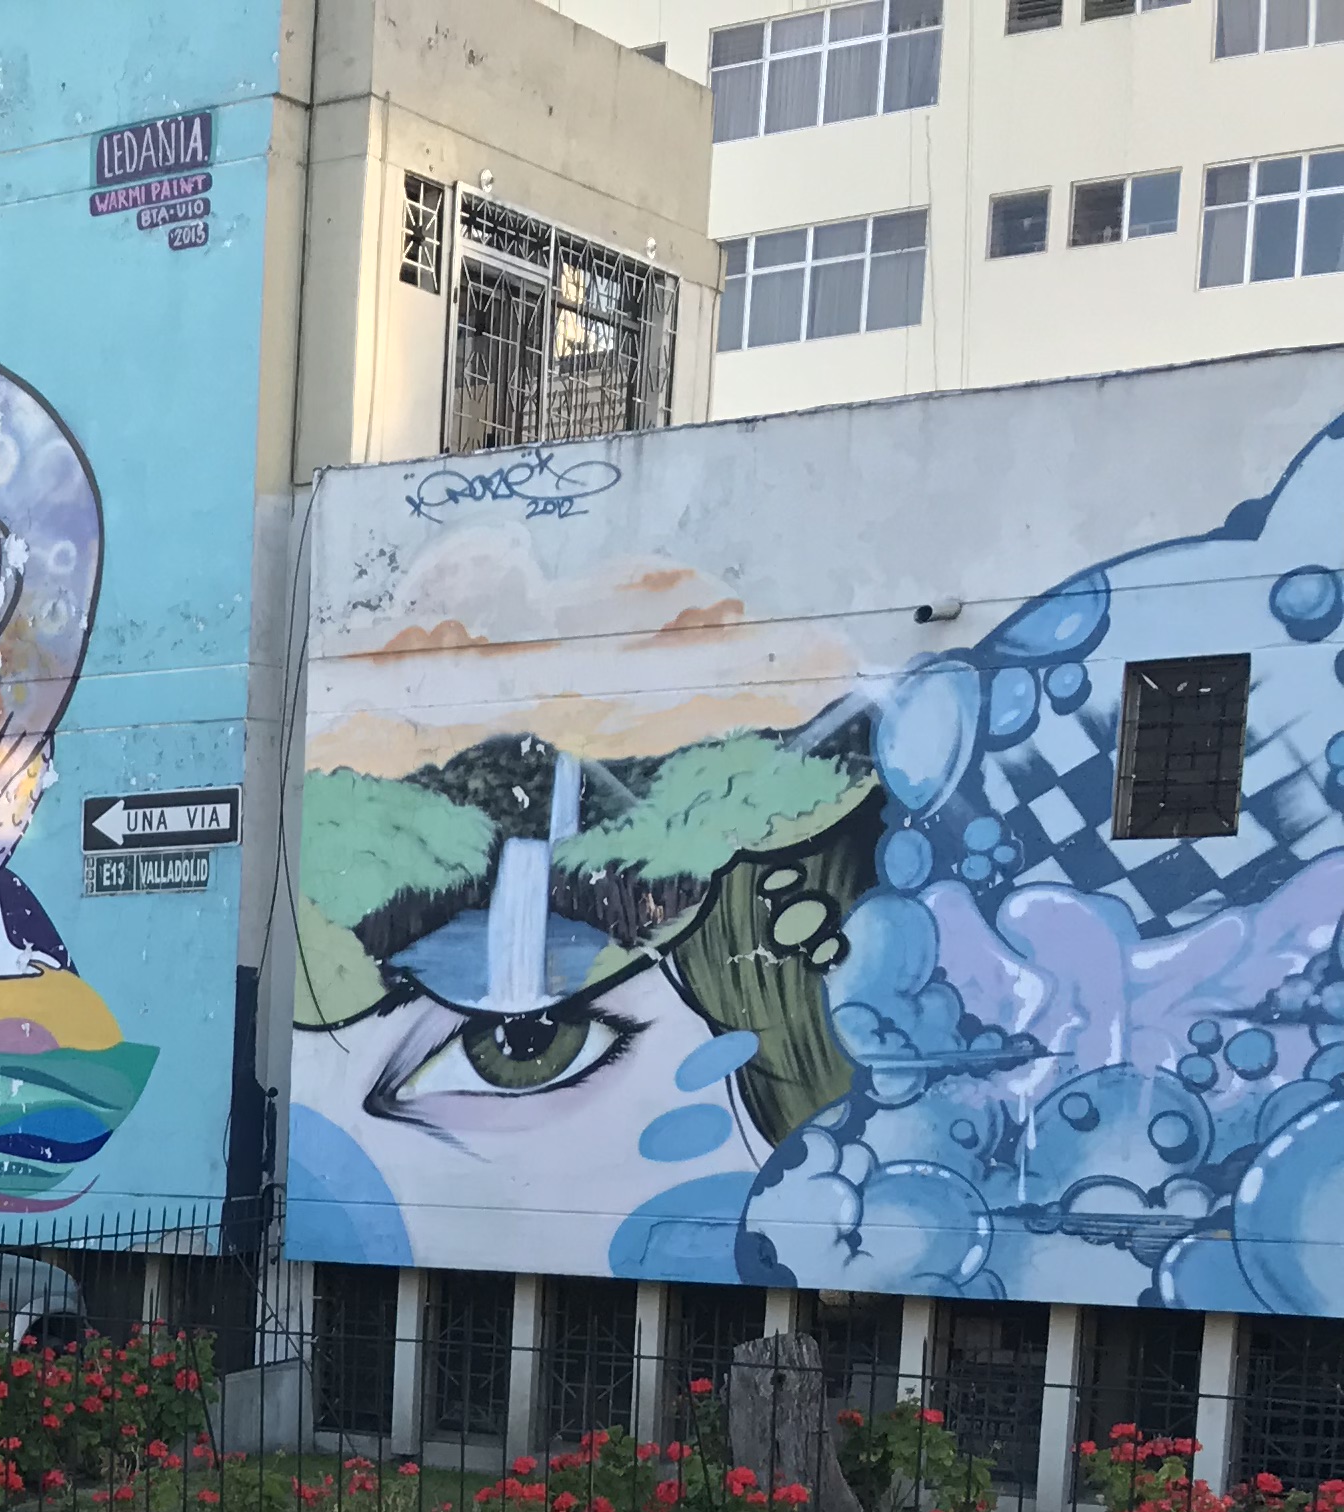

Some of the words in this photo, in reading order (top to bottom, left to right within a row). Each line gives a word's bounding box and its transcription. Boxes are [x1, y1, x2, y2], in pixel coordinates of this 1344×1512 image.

[95, 186, 146, 213] WARMI
[151, 175, 206, 202] PAINT
[526, 498, 588, 519] 2012
[127, 809, 168, 832] UNA
[186, 806, 221, 829] VIA
[102, 862, 125, 886] E13
[140, 858, 208, 885] VALLADOLID
